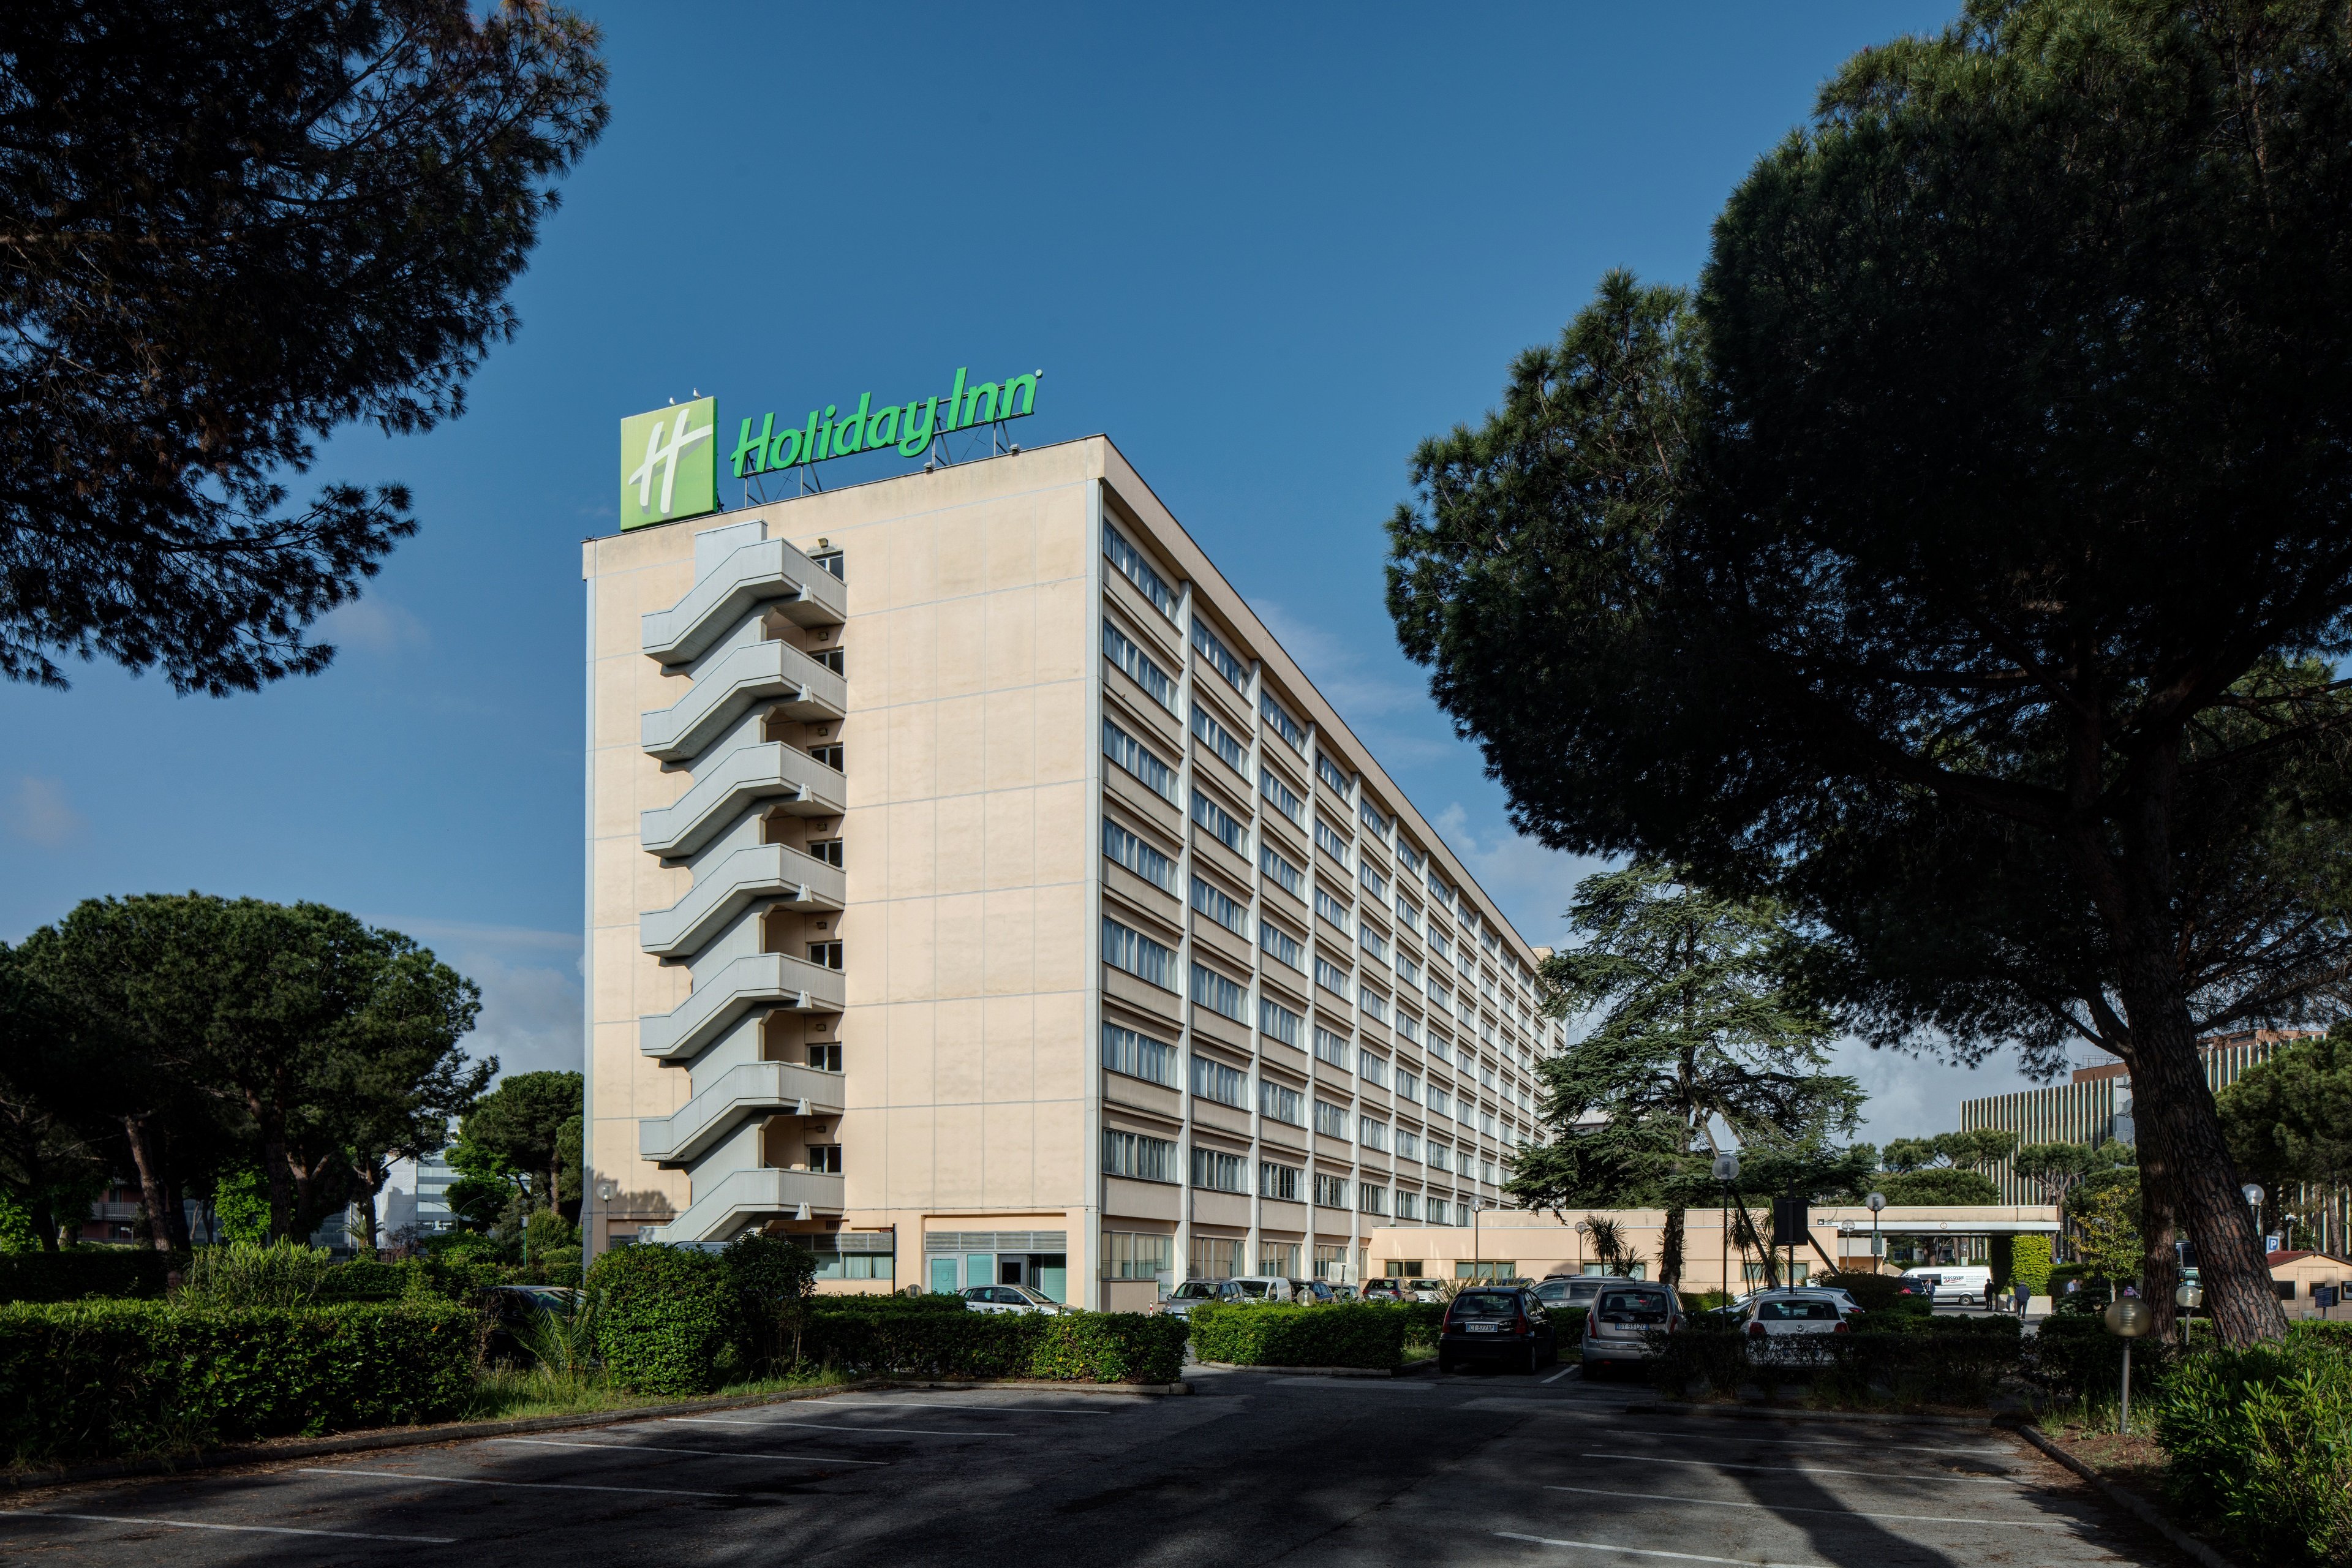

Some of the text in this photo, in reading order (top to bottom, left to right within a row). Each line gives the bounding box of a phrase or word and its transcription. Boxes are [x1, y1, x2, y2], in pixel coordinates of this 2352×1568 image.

[628, 408, 713, 513] H
[730, 367, 1038, 478] Holiday Inn
[2270, 1239, 2277, 1249] P
